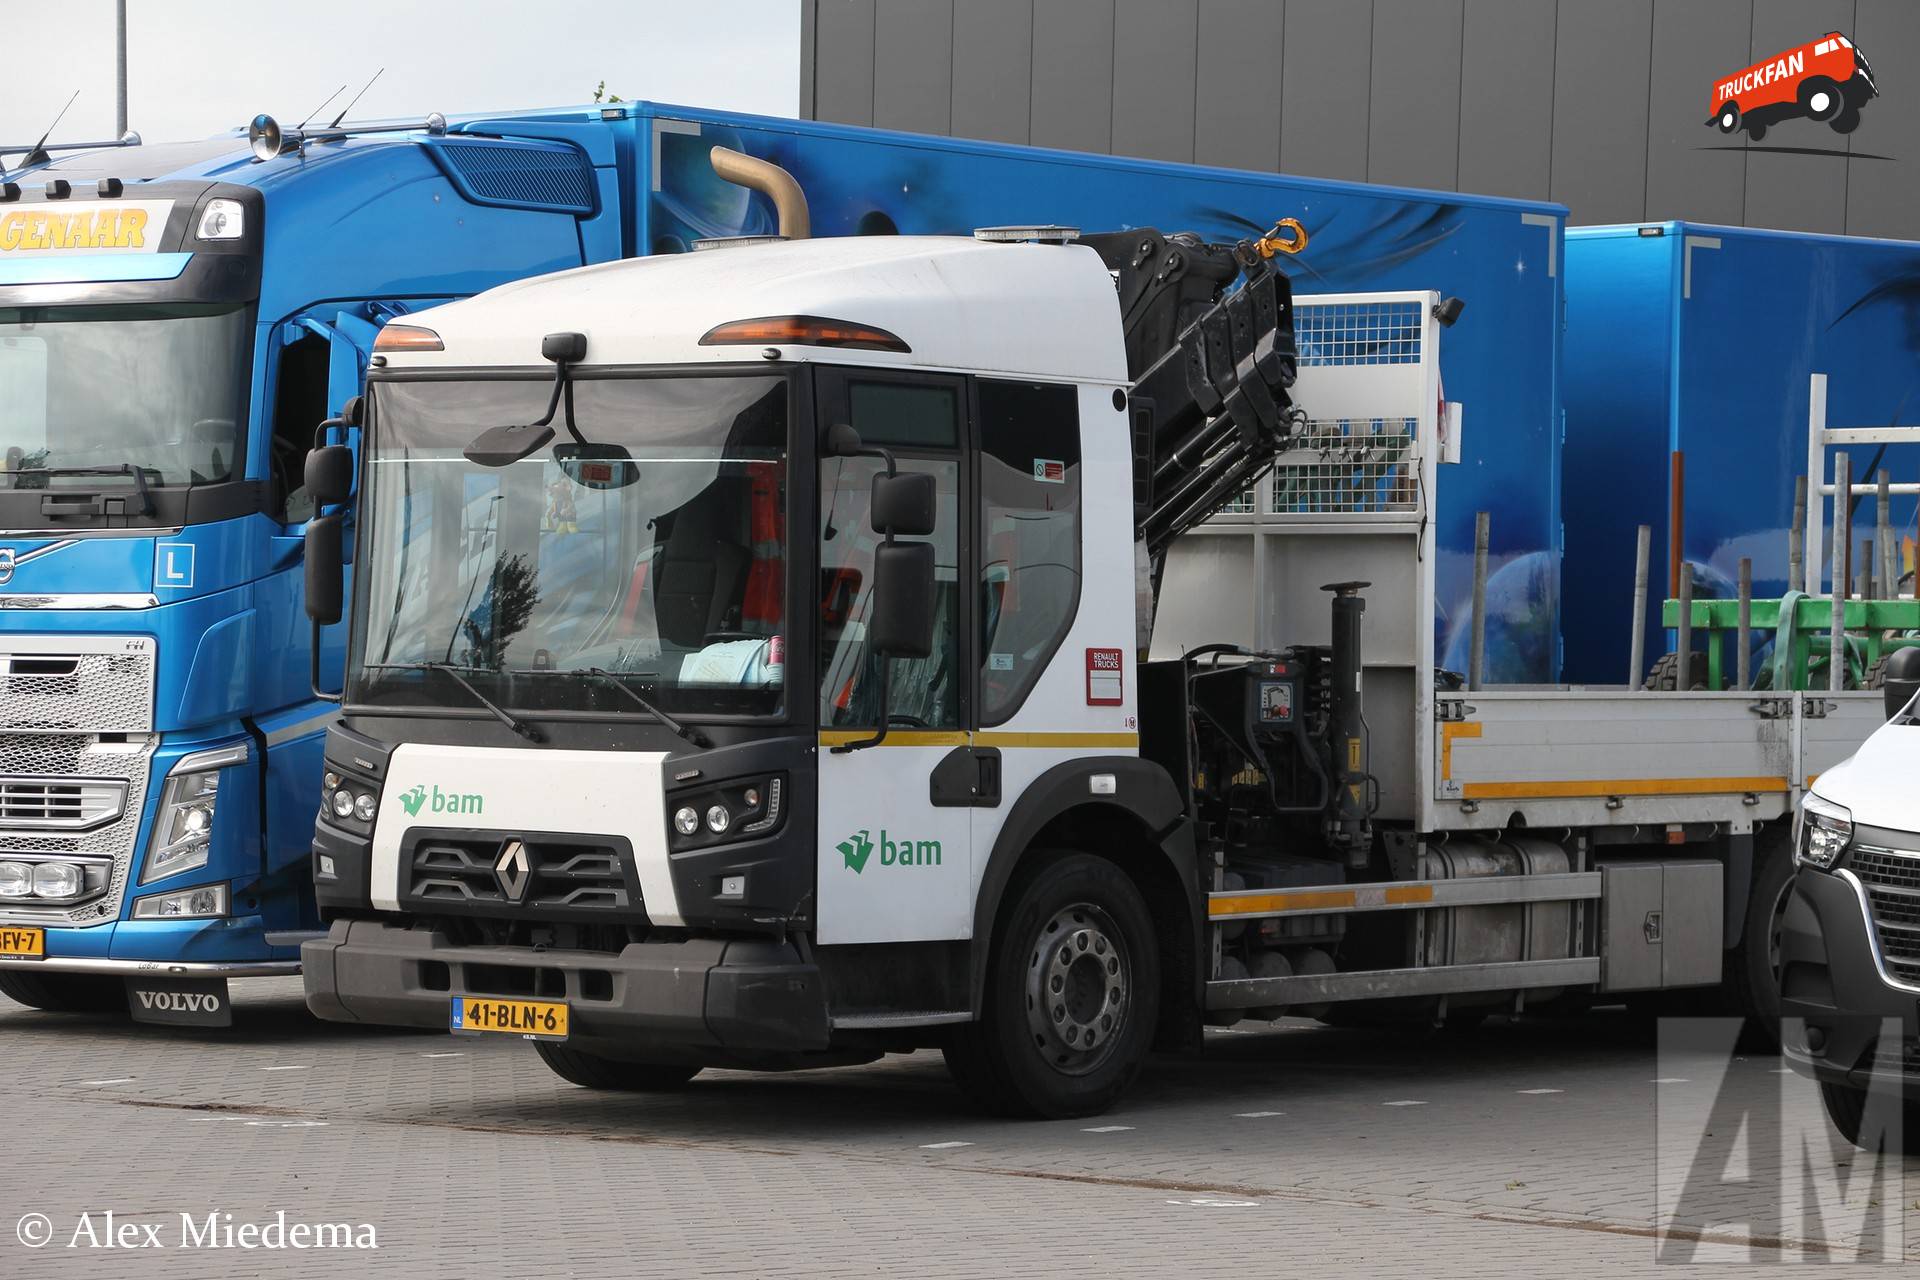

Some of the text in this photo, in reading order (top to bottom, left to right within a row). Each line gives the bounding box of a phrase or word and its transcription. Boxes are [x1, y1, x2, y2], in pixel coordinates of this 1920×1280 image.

[0, 208, 148, 251] GENAAR
[167, 552, 184, 579] L
[1093, 652, 1118, 660] RENAULT
[1094, 660, 1119, 668] TRUCKS
[432, 785, 483, 814] bam
[881, 829, 942, 866] bam
[0, 931, 36, 951] FV-7
[136, 991, 220, 1012] VOLVO
[453, 1015, 462, 1024] NL
[469, 1003, 556, 1030] 41-BLN-6
